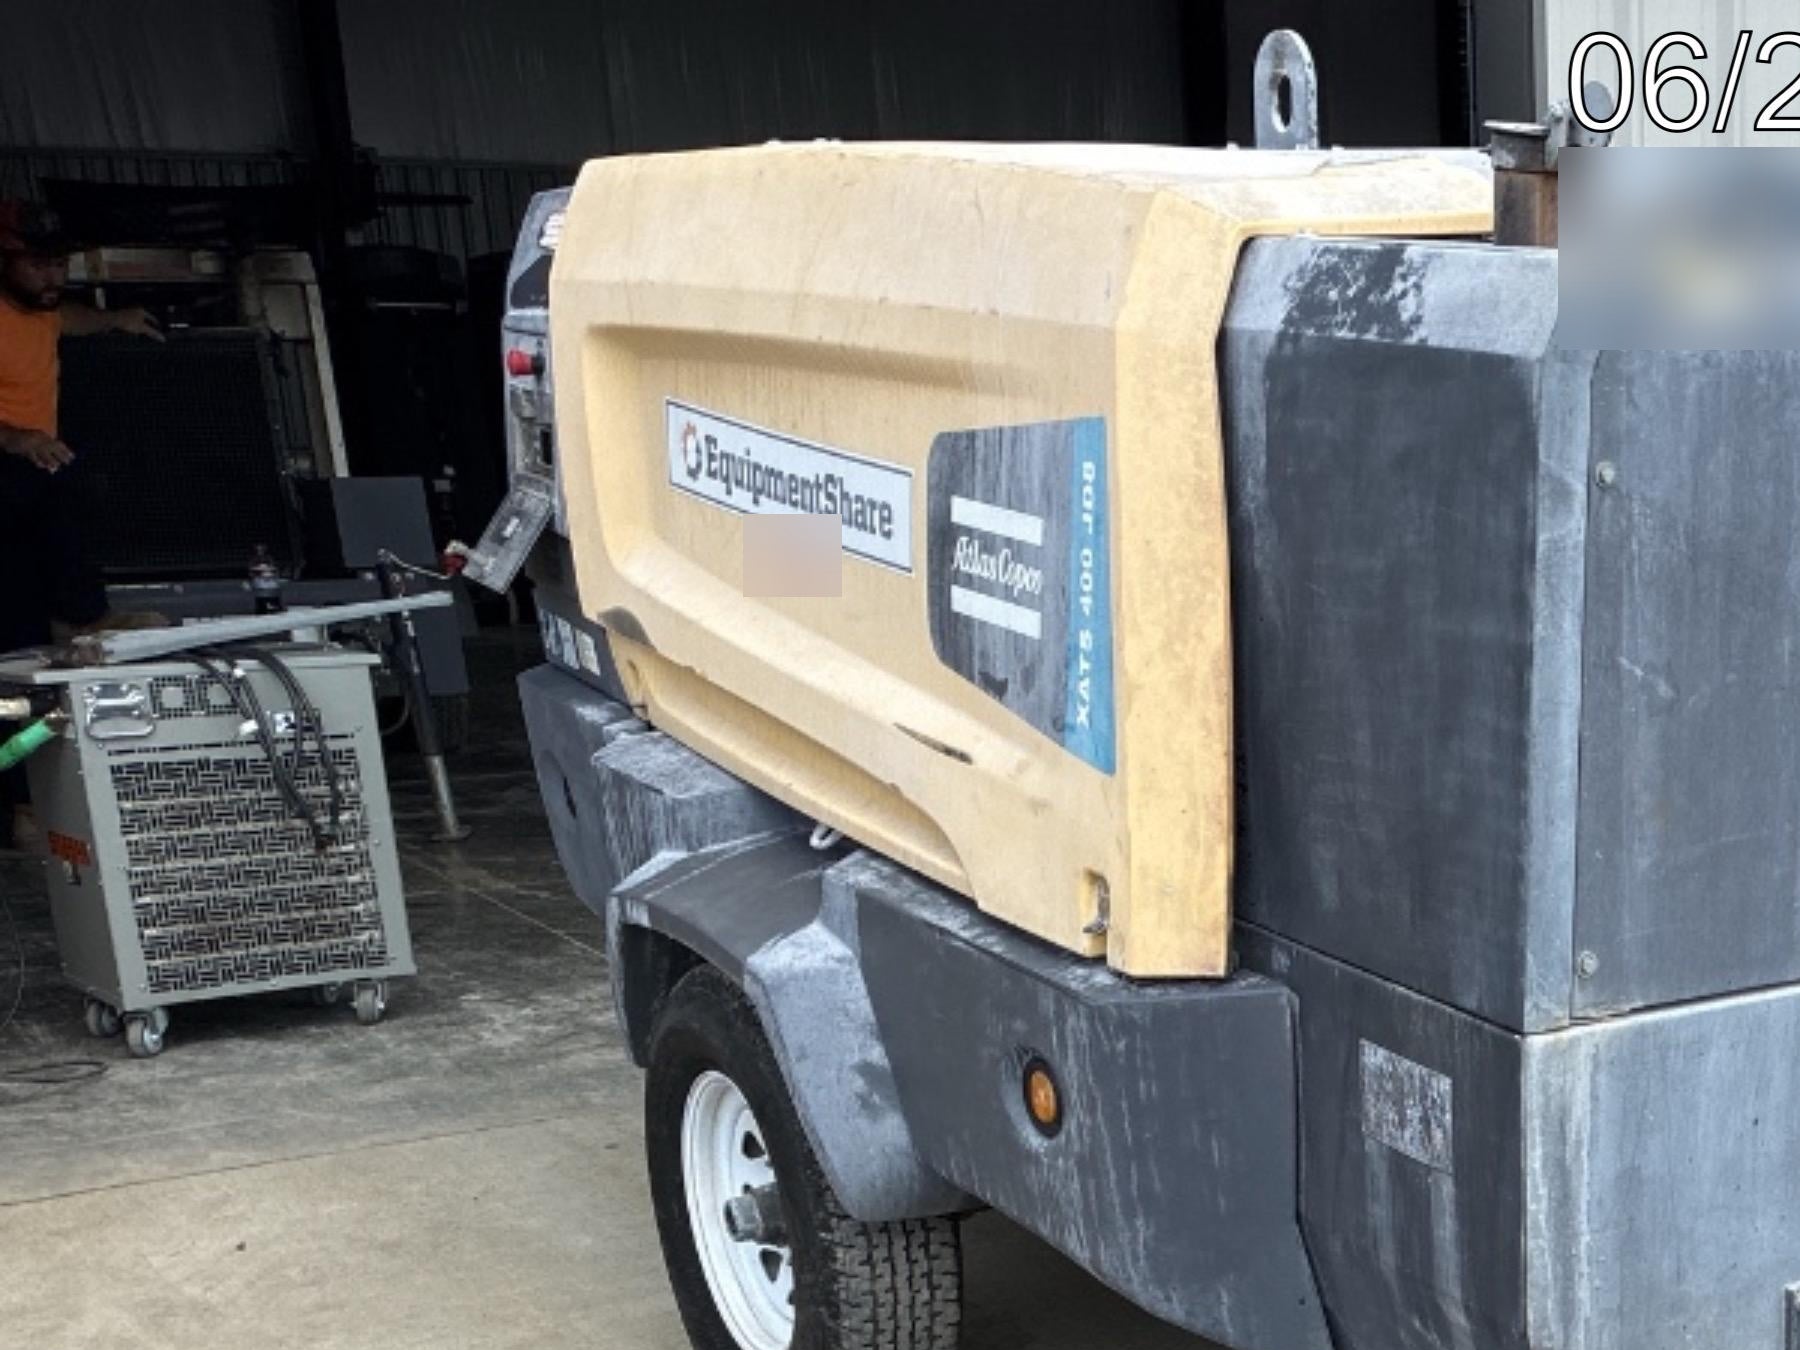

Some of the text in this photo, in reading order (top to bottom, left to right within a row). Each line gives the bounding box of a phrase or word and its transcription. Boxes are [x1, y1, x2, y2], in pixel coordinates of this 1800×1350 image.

[704, 432, 893, 541] EquipmentShare
[951, 536, 997, 580] Atlas
[1079, 548, 1093, 616] 400
[1076, 628, 1093, 729] XATS
